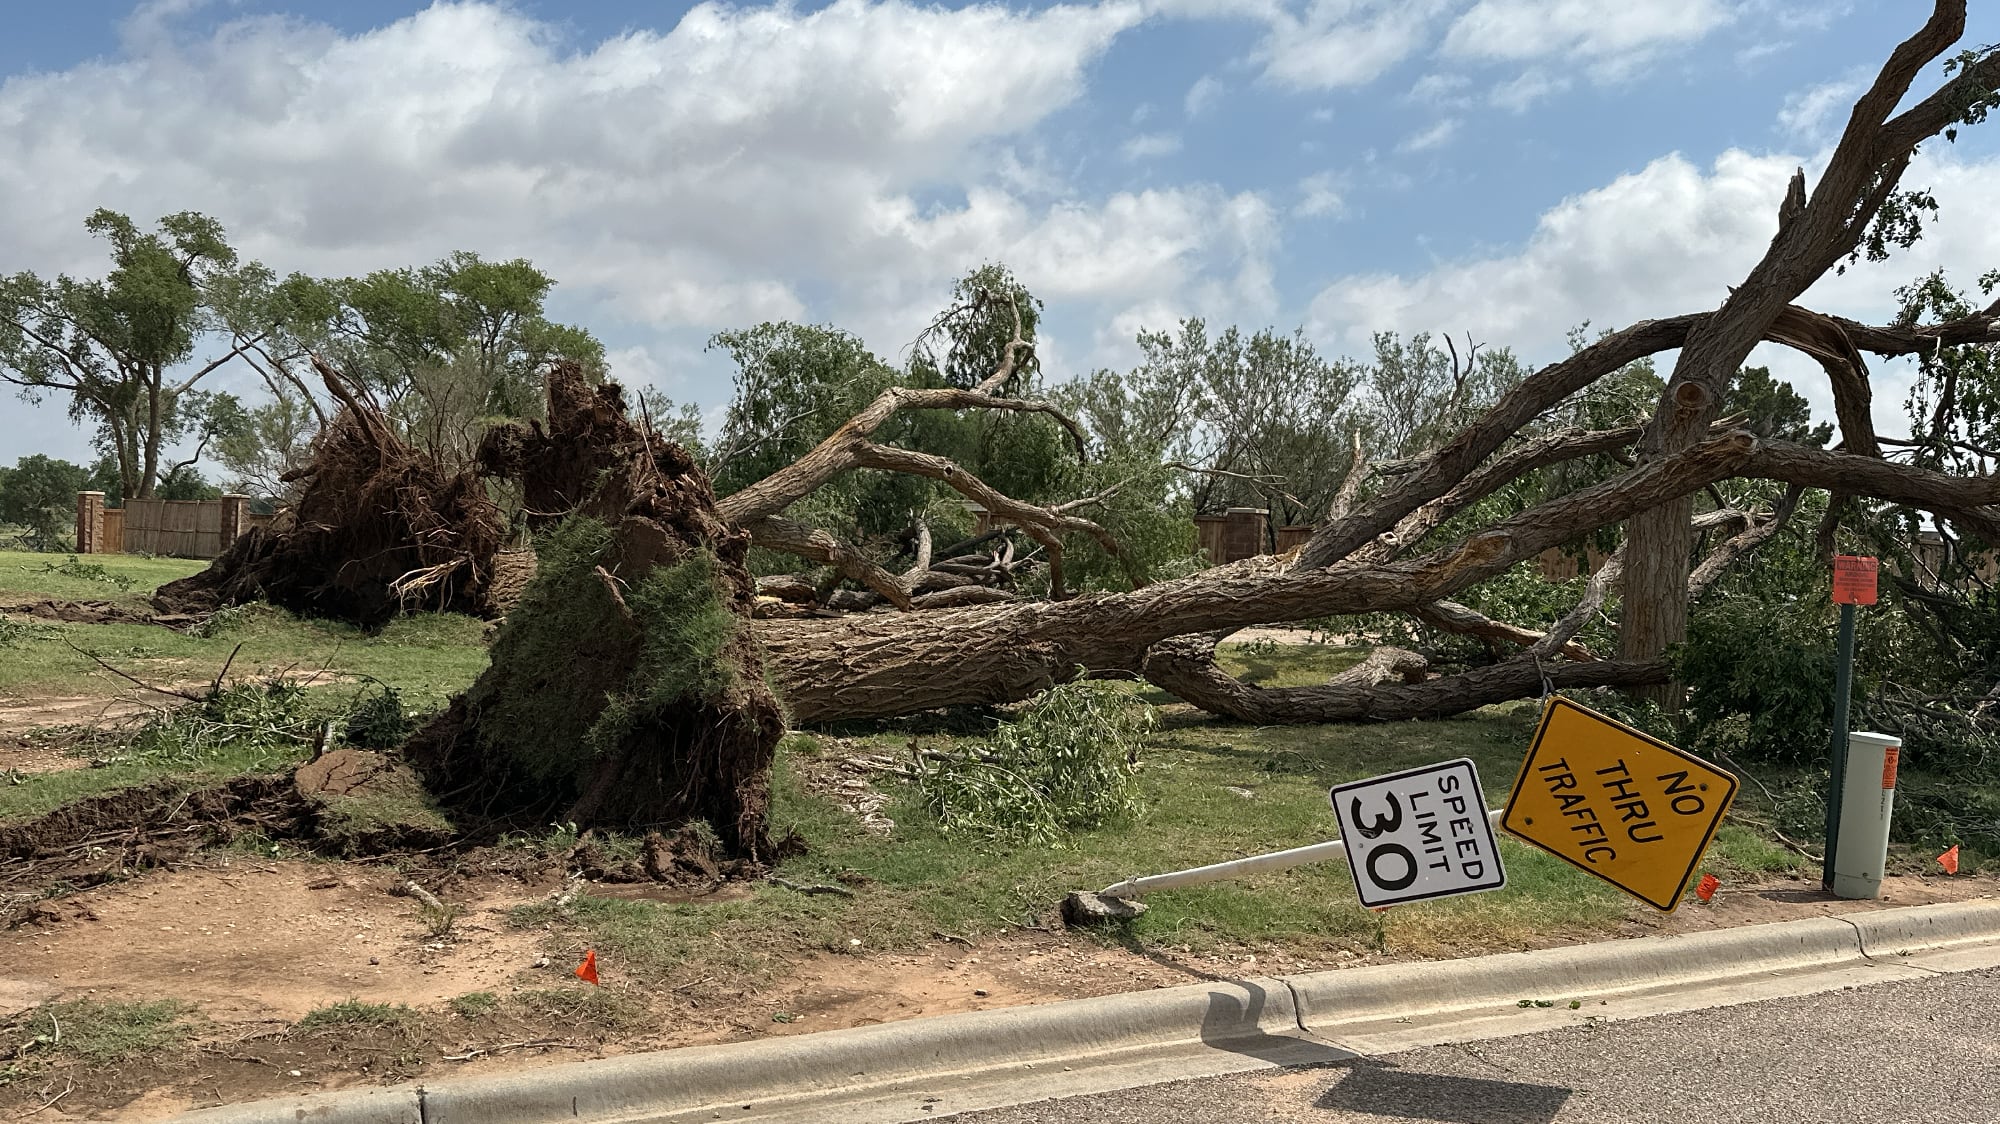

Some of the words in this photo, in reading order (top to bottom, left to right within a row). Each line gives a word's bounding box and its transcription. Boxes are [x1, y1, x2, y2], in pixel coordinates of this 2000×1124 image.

[1838, 560, 1876, 571] WARNING
[1409, 791, 1450, 873] LIMIT
[1438, 775, 1484, 880] SPEED
[1538, 757, 1617, 864] TRAFFIC
[1595, 758, 1665, 843] THRU
[1656, 770, 1705, 815] NO
[1350, 790, 1418, 891] 30
